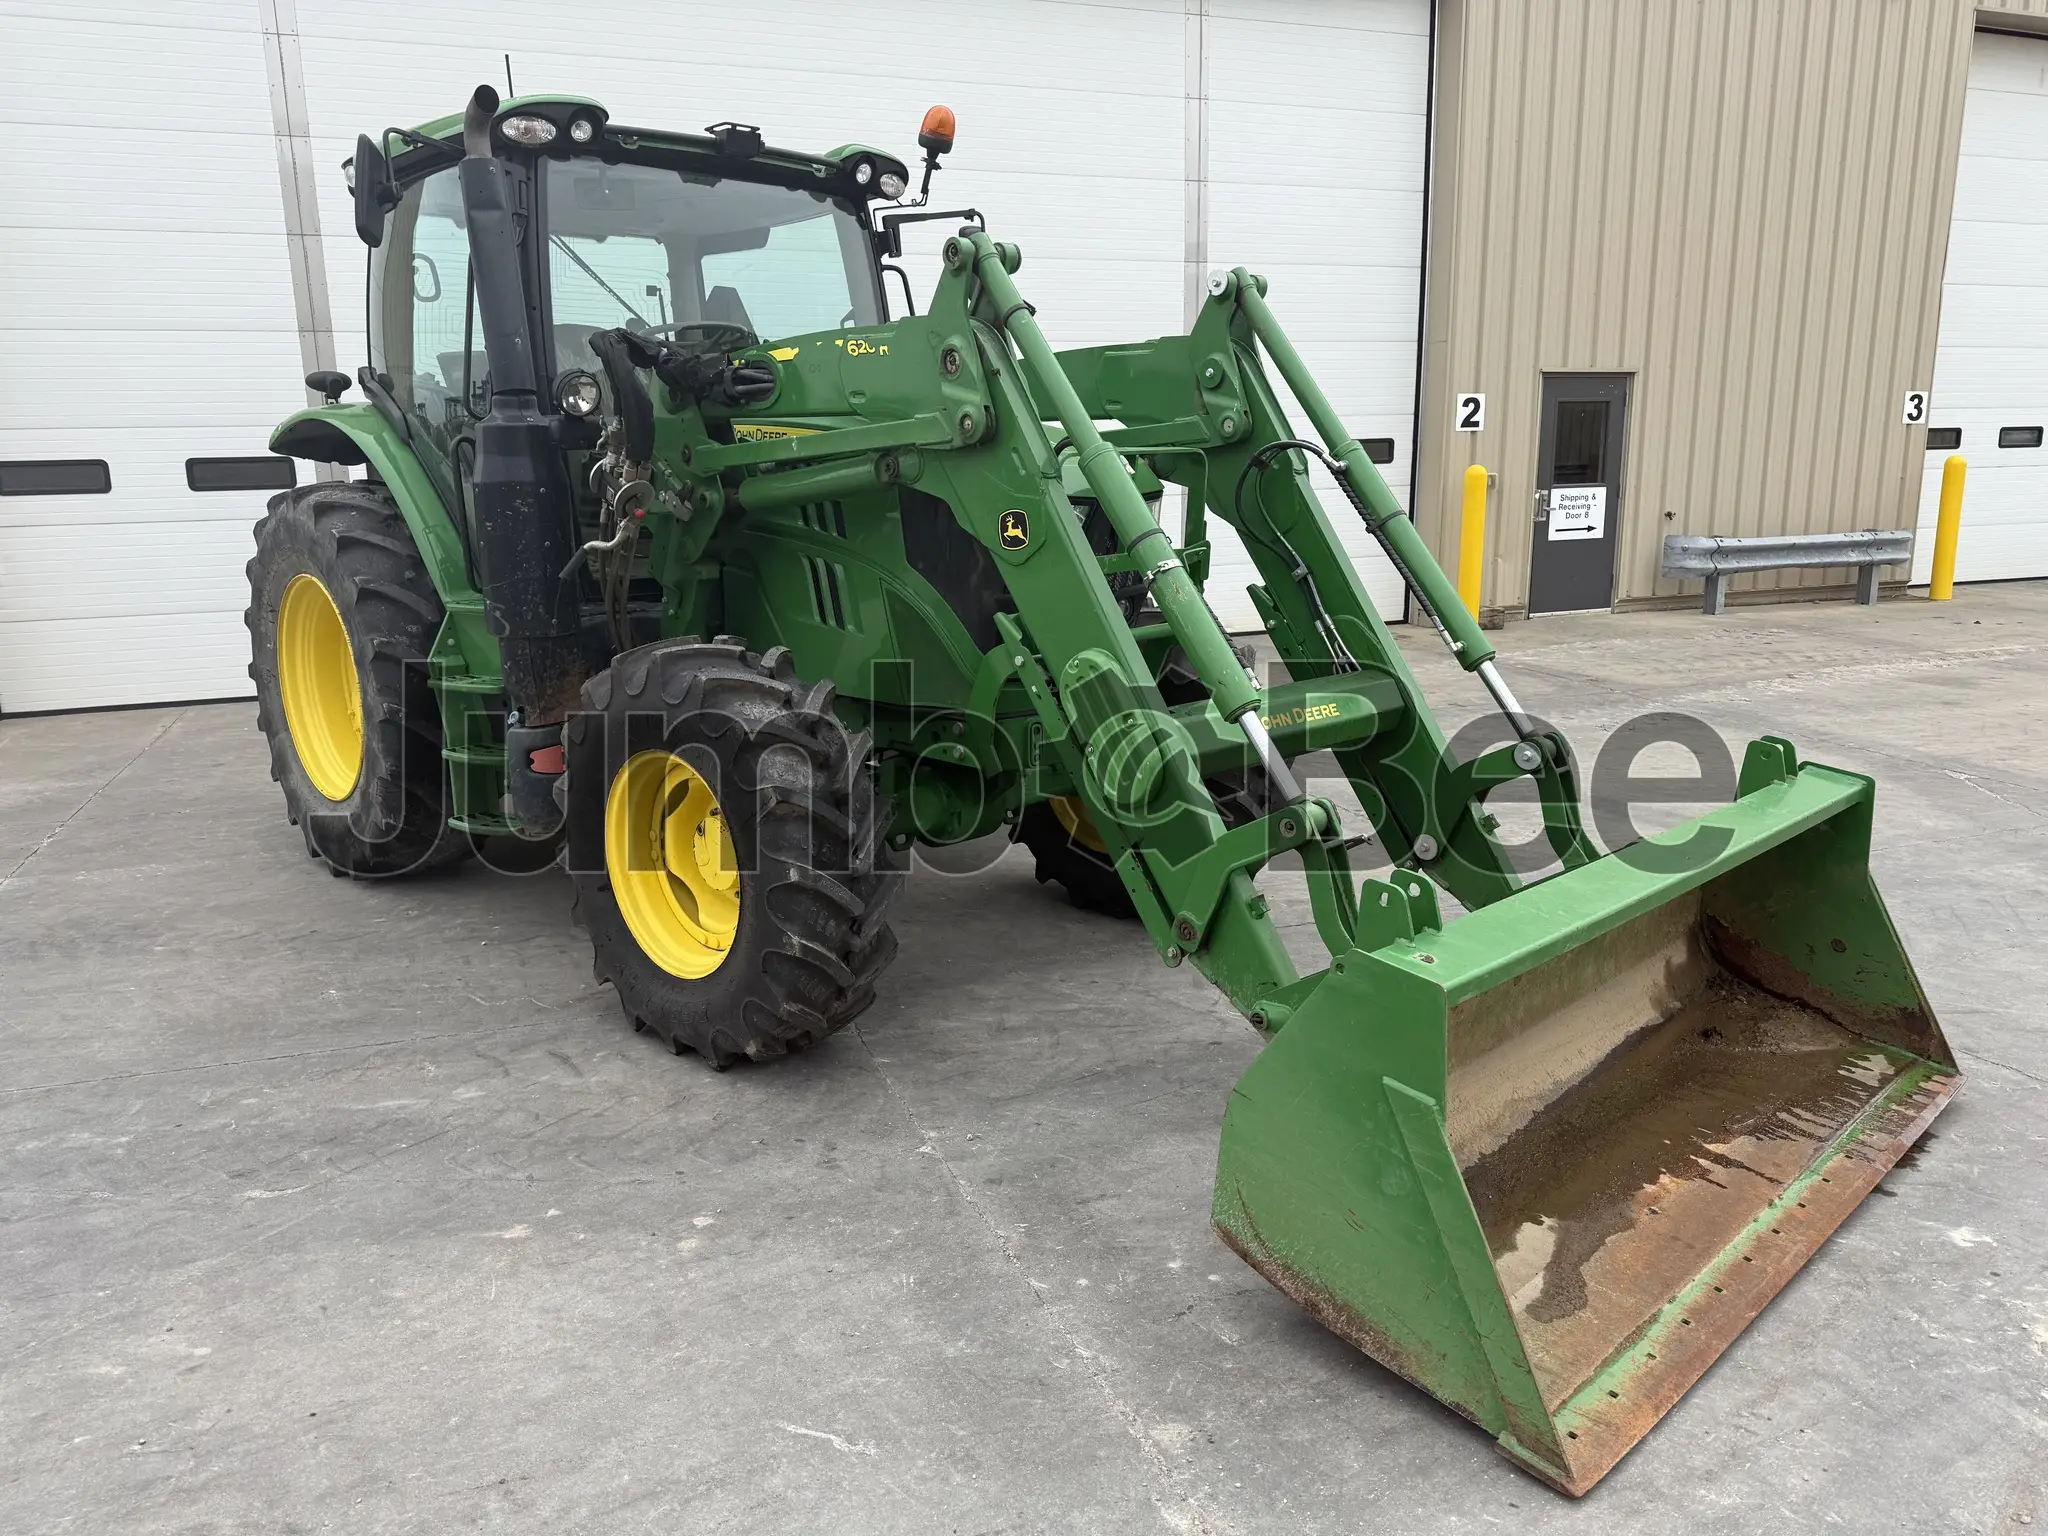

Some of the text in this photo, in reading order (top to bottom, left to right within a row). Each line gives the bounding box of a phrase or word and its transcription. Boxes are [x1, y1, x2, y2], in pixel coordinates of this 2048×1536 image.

[1460, 396, 1481, 428] 2
[1907, 393, 1924, 421] 3
[735, 430, 755, 440] OHN
[1560, 493, 1597, 502] Shipping &
[1558, 503, 1591, 511] Receiving
[1565, 511, 1582, 519] Door
[1260, 703, 1340, 731] OHN DEERE
